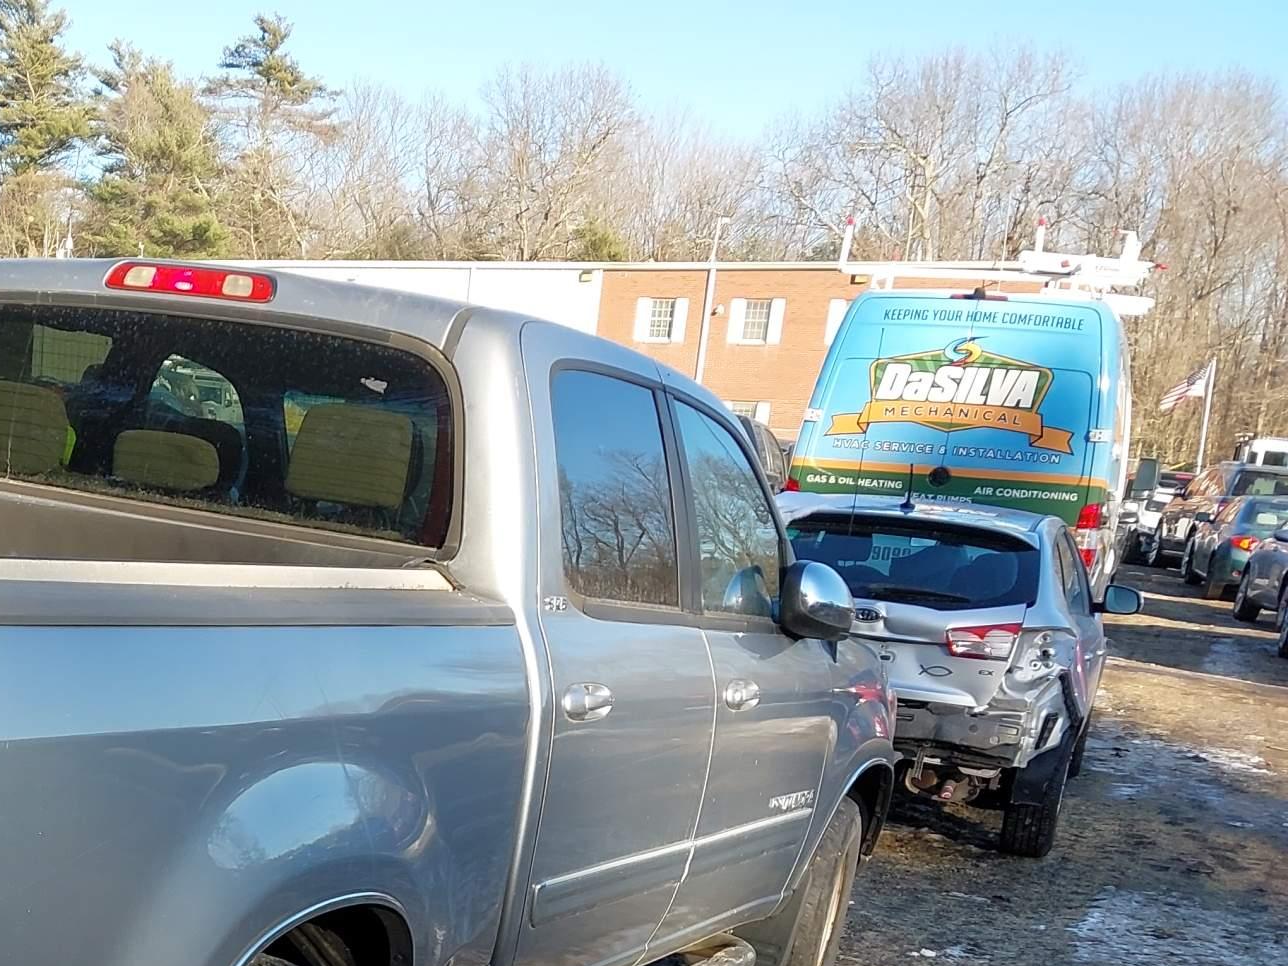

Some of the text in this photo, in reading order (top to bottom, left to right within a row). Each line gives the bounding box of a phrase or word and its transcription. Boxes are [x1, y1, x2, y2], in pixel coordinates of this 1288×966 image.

[883, 308, 1085, 331] KEEPING YOUR HOME COMFORTABLE
[875, 363, 1041, 409] DaSILVA
[884, 406, 1022, 426] MECHANICAL
[832, 438, 1061, 464] HVAC SERVICE & INSTALLATION
[806, 474, 903, 490] GAS & OIL HEATING
[974, 486, 1079, 502] AIR CONDITIONING
